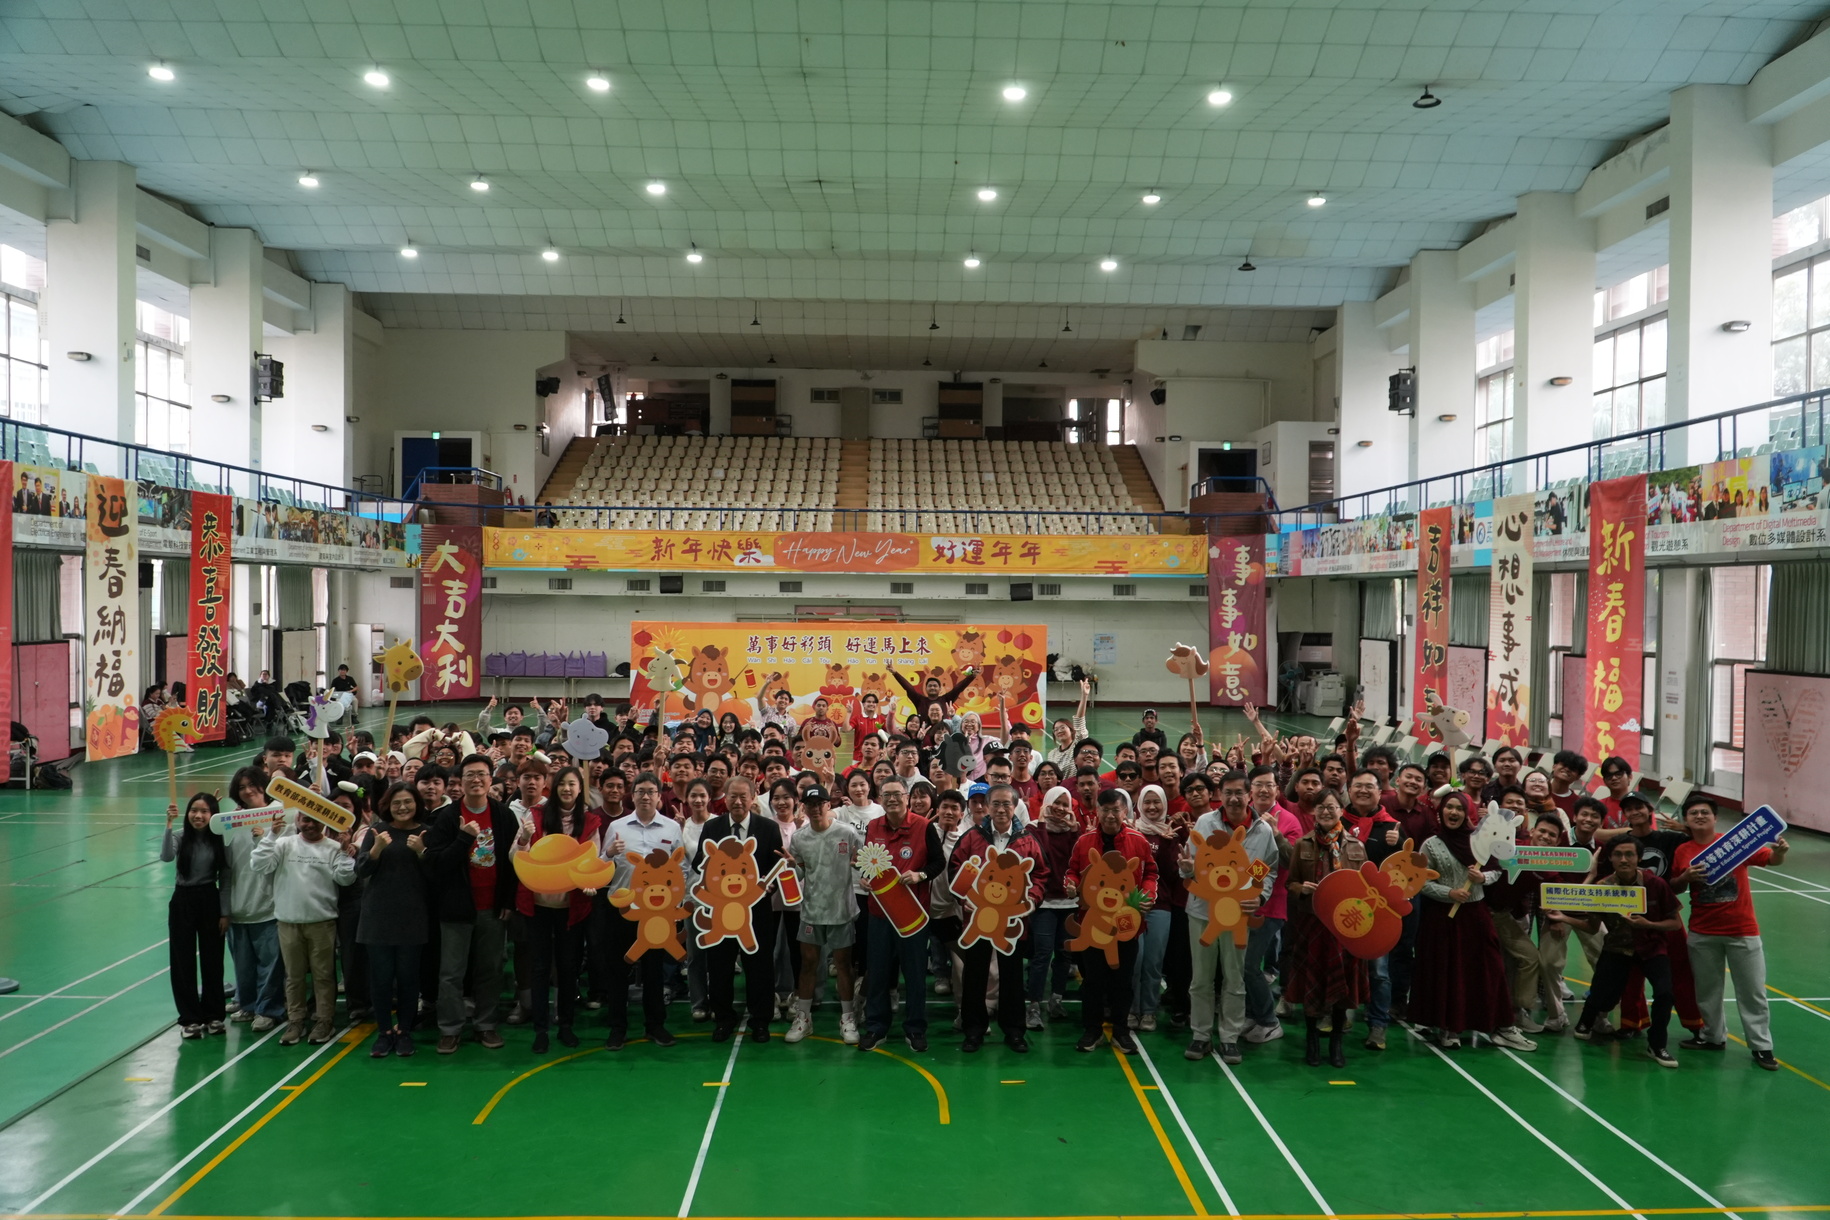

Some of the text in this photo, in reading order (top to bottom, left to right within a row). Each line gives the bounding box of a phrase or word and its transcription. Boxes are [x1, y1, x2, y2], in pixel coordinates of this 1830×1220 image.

[1722, 522, 1755, 533] Department
[1756, 521, 1763, 532] of
[1763, 518, 1781, 532] Digital
[1748, 528, 1826, 547] 數位多媒體設計系
[651, 536, 762, 564] 新年快樂
[782, 537, 912, 564] Happy New Year
[932, 539, 1041, 566] 好運年年
[1651, 538, 1689, 552] 觀光遊憩系
[1722, 536, 1741, 548] Design
[93, 485, 129, 698] 迎春納福
[196, 511, 224, 729] 恭喜發財
[431, 539, 473, 695] 大吉大利
[1217, 545, 1257, 701] 事事如意
[1497, 511, 1528, 711] 心想事成
[747, 635, 932, 655] 萬事好彩頭 好運馬上來
[232, 813, 251, 821] TEAM
[274, 783, 347, 825] 教育部高教深耕計畫
[1720, 849, 1743, 869] Education
[1741, 835, 1757, 851] Sprout
[1756, 824, 1775, 840] Project
[1252, 864, 1264, 876] 財
[1119, 918, 1131, 930] 旺
[1339, 905, 1366, 931] 春
